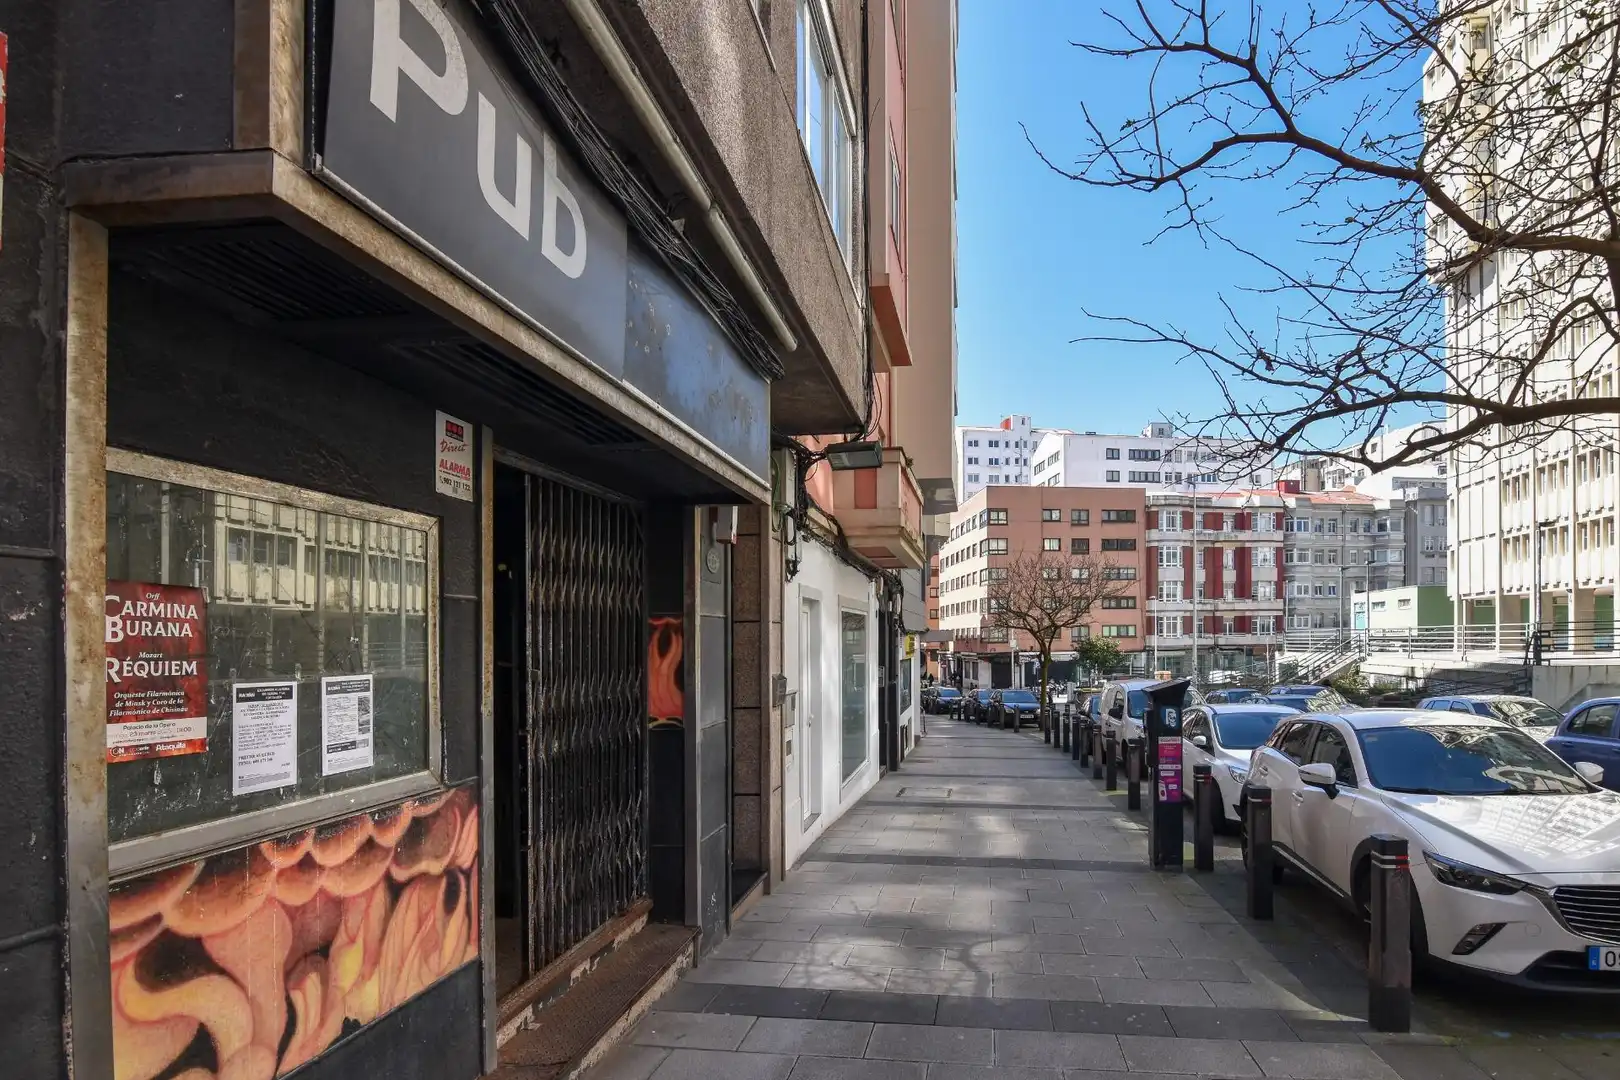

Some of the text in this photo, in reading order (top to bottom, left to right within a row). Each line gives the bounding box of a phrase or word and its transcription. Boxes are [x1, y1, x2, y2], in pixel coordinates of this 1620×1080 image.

[370, 0, 587, 279] Pub
[439, 458, 471, 476] ALARMA
[145, 592, 160, 600] Orff
[105, 615, 193, 642] BURANA
[105, 656, 198, 682] RÉQUIEM
[114, 691, 145, 700] Orquesta
[1605, 951, 1620, 967] 0
